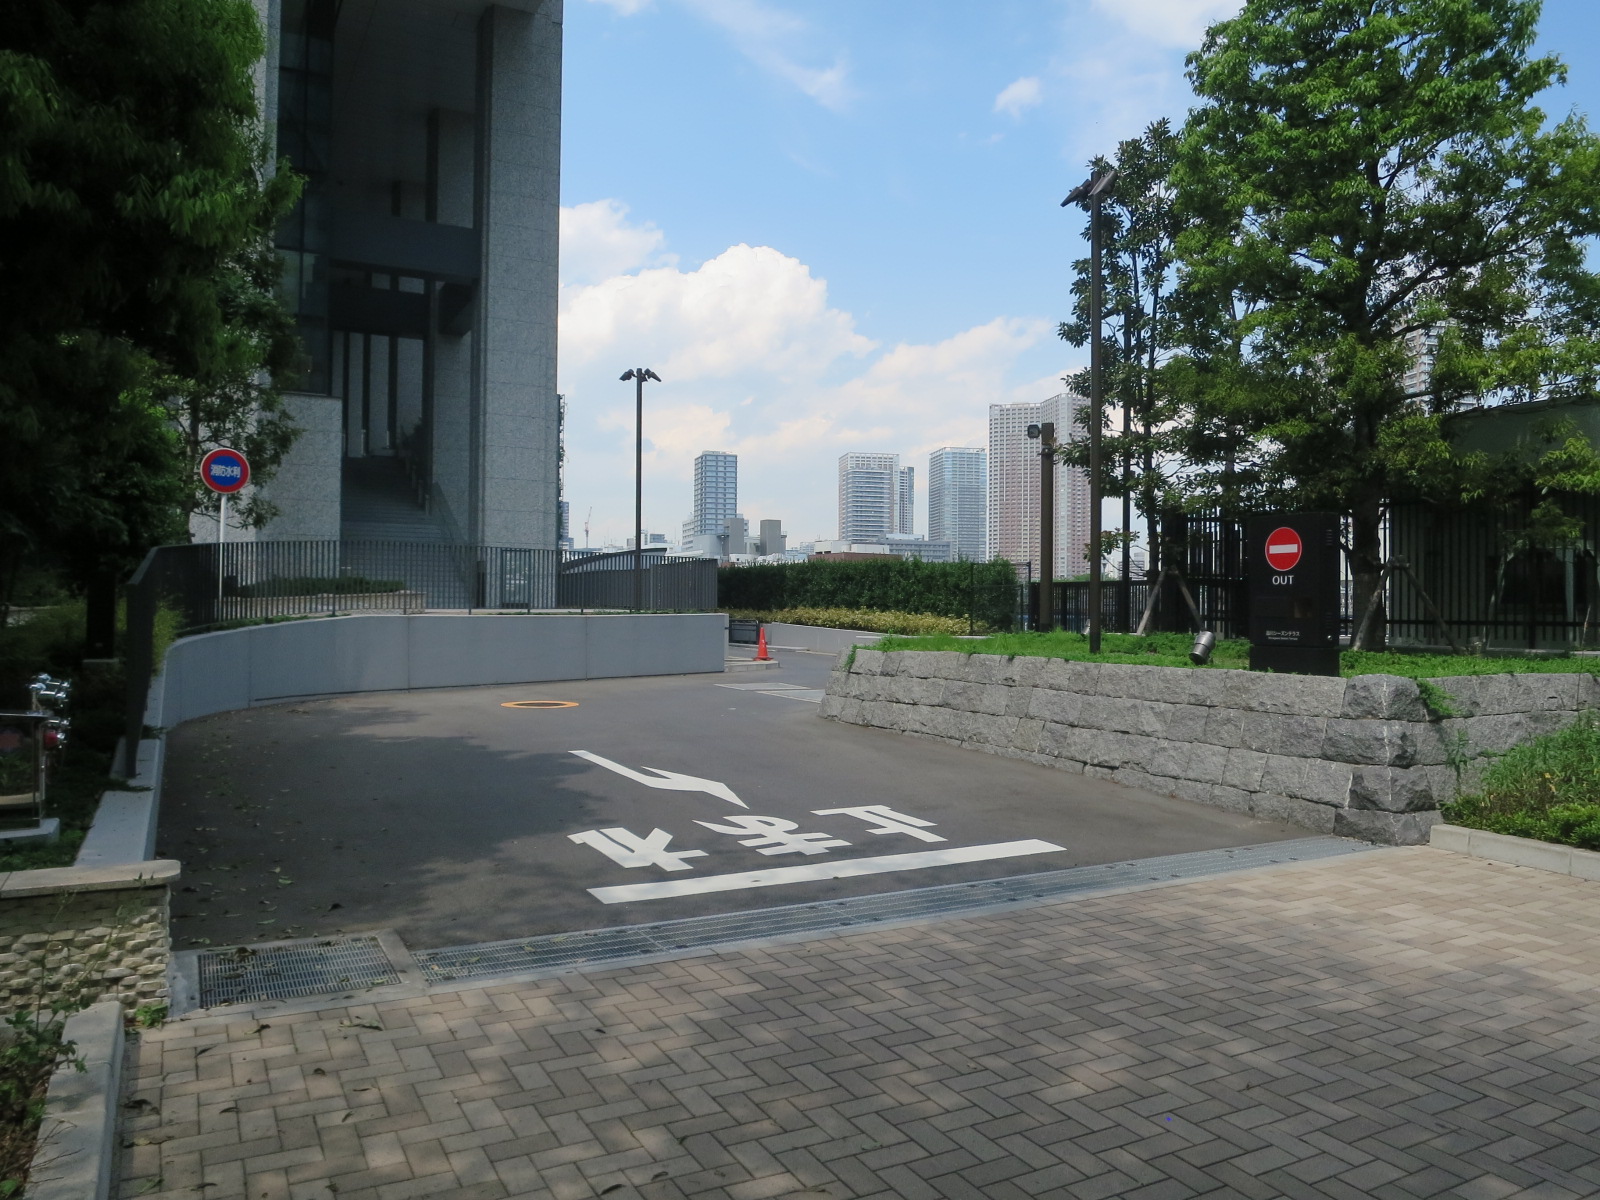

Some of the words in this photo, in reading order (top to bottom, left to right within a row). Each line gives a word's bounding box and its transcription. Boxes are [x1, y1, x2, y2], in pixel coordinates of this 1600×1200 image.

[1272, 575, 1294, 585] OUT
[567, 804, 948, 872] 止まれ
